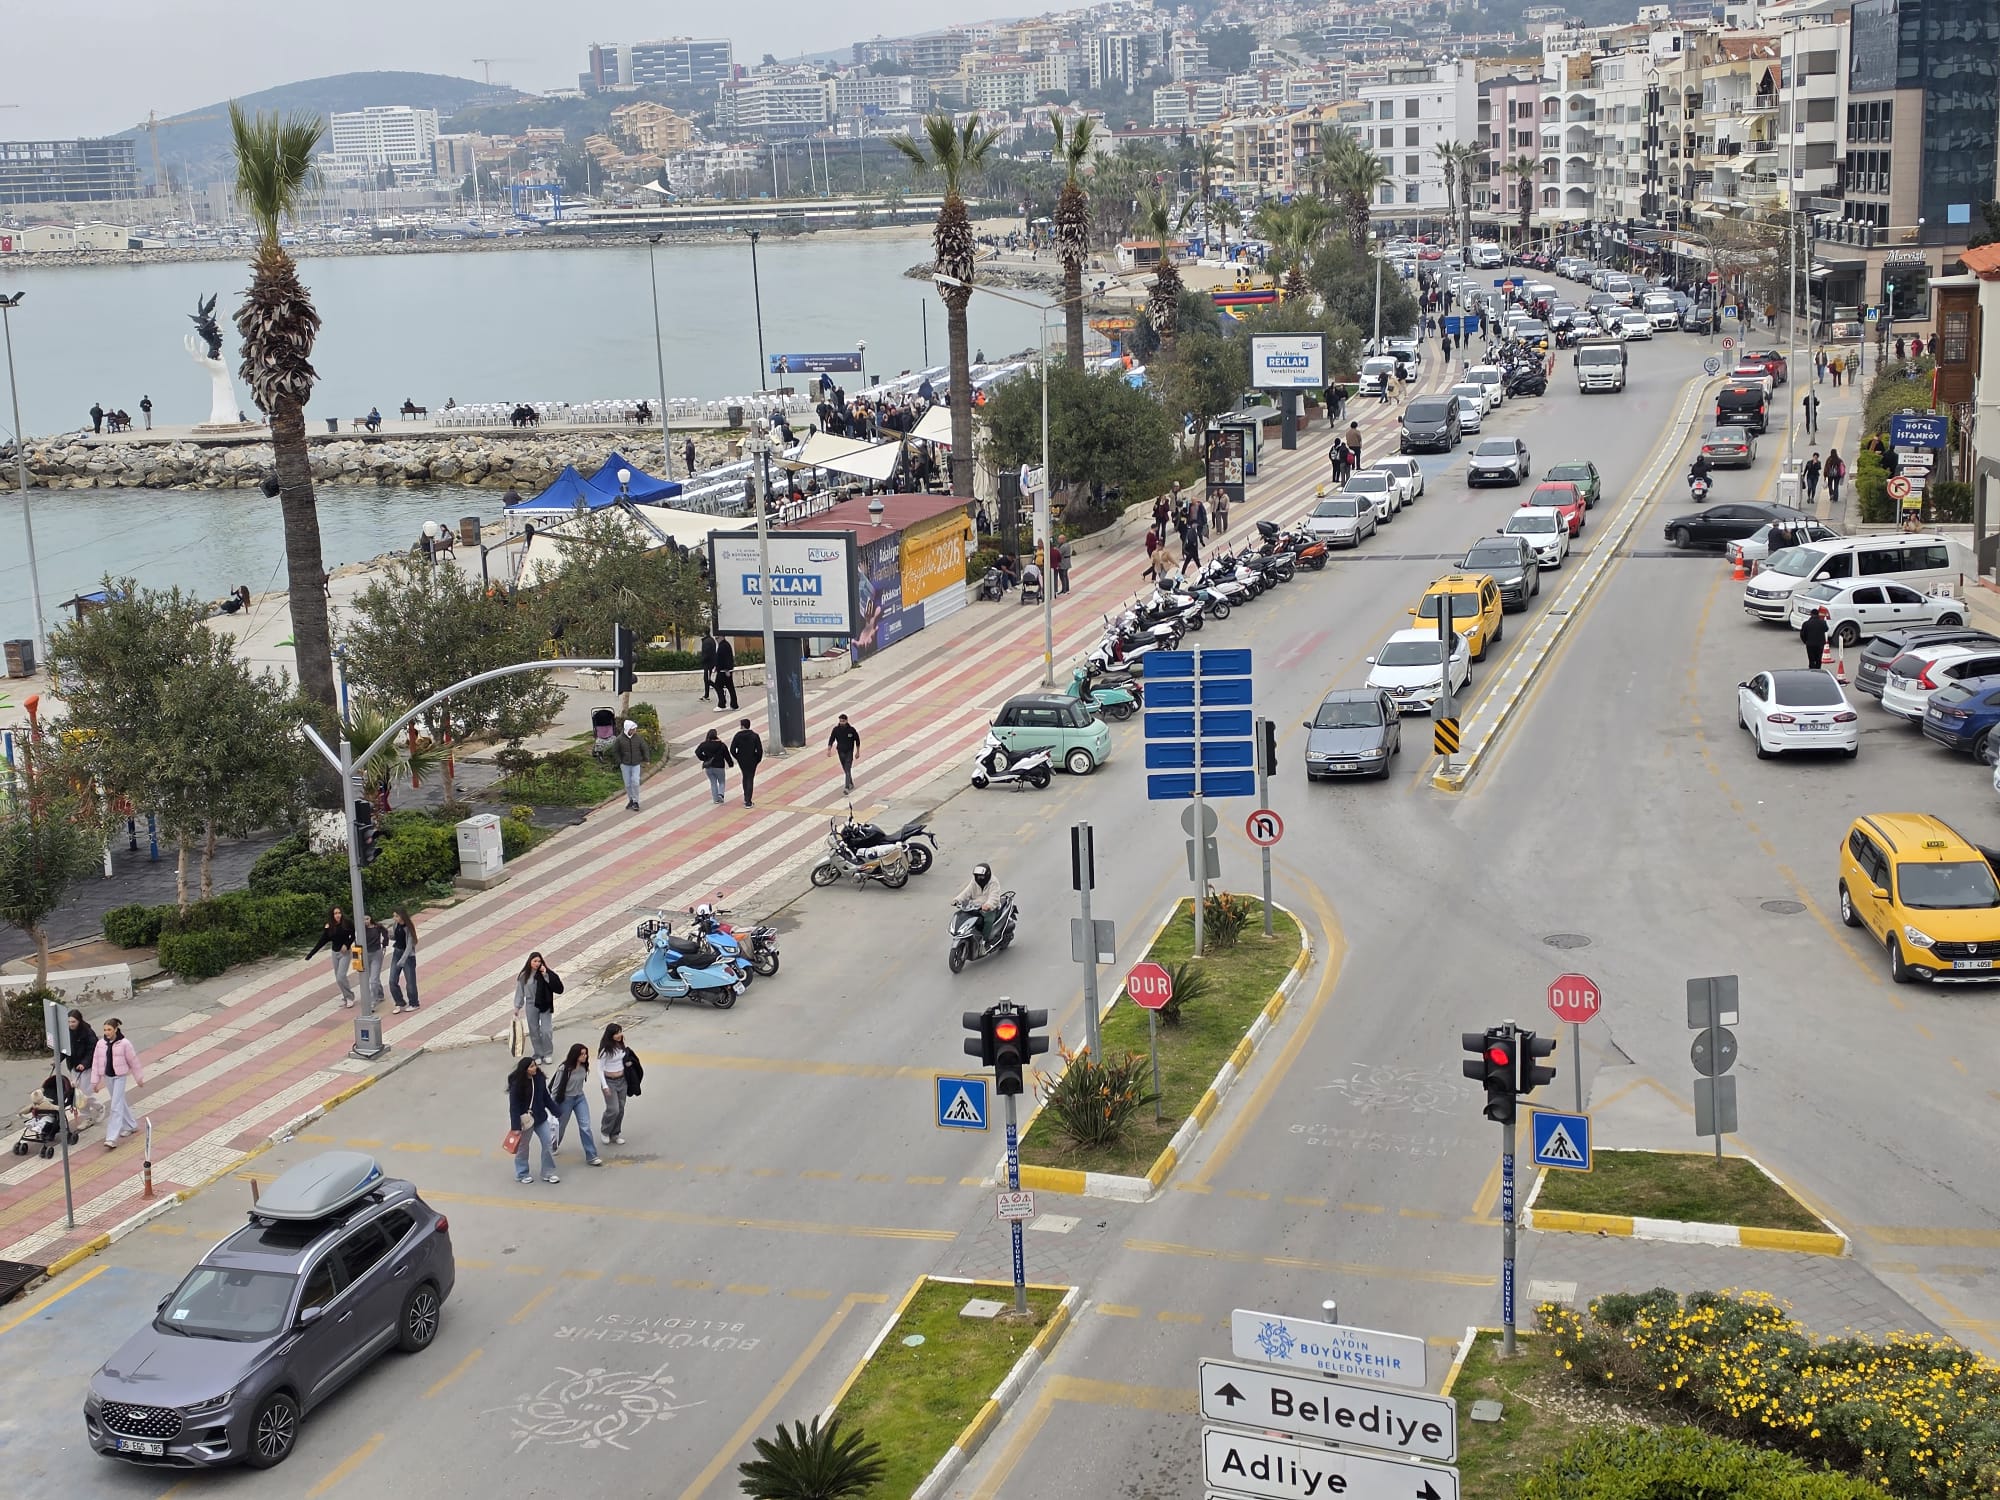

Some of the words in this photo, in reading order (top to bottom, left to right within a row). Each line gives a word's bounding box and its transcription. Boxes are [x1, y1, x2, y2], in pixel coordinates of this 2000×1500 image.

[1269, 358, 1306, 366] REKLAM
[774, 565, 804, 574] Alana
[747, 578, 817, 592] RKLAM
[751, 597, 816, 606] Vebilirsiniz
[1130, 976, 1168, 995] DUR
[1553, 989, 1595, 1009] DUR
[1504, 1188, 1512, 1196] 40
[1504, 1197, 1512, 1205] 09
[1332, 1338, 1369, 1351] AYDIN
[1300, 1343, 1401, 1370] BÜYÜKŞEHİR
[1317, 1360, 1386, 1379] BELEDİYESİ
[1270, 1387, 1443, 1446] Belediye
[1221, 1447, 1348, 1496] Adliye
